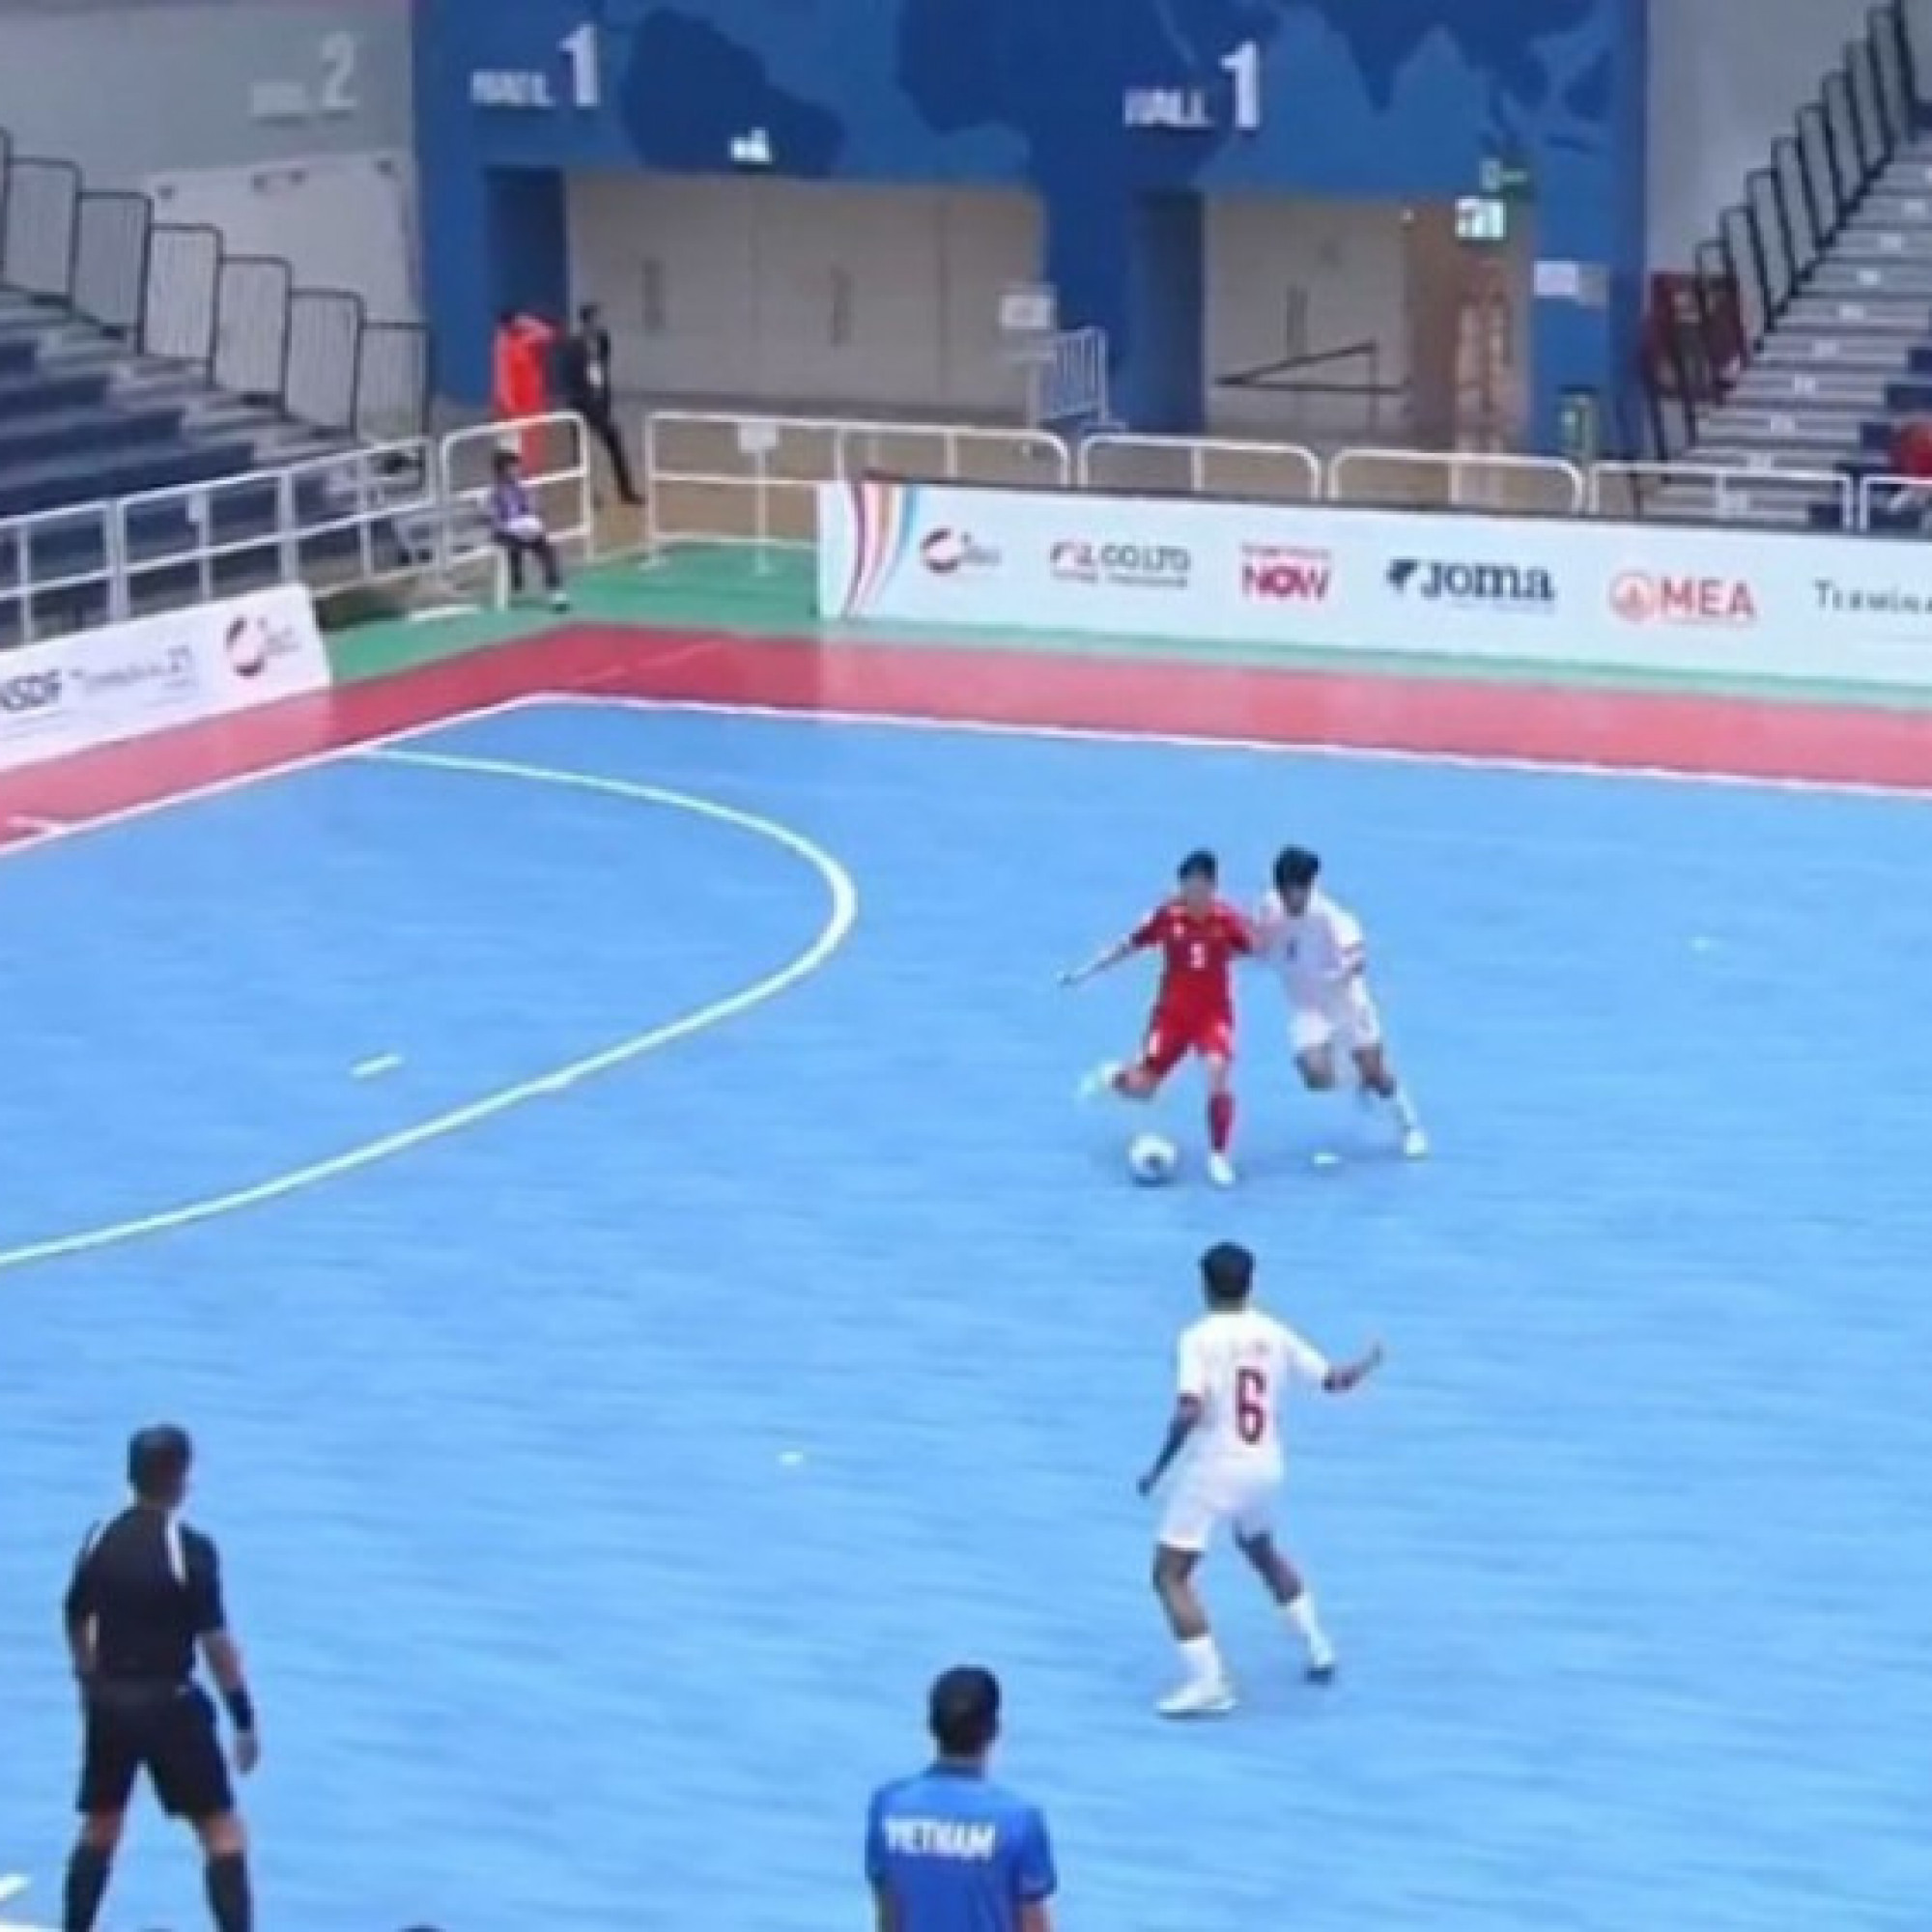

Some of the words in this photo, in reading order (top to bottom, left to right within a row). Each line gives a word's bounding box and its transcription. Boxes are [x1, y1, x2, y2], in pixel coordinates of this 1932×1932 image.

[320, 33, 357, 108] 2
[556, 23, 599, 108] 1
[1218, 41, 1260, 128] 1
[1659, 576, 1757, 621] MEA
[1236, 1367, 1266, 1446] 6
